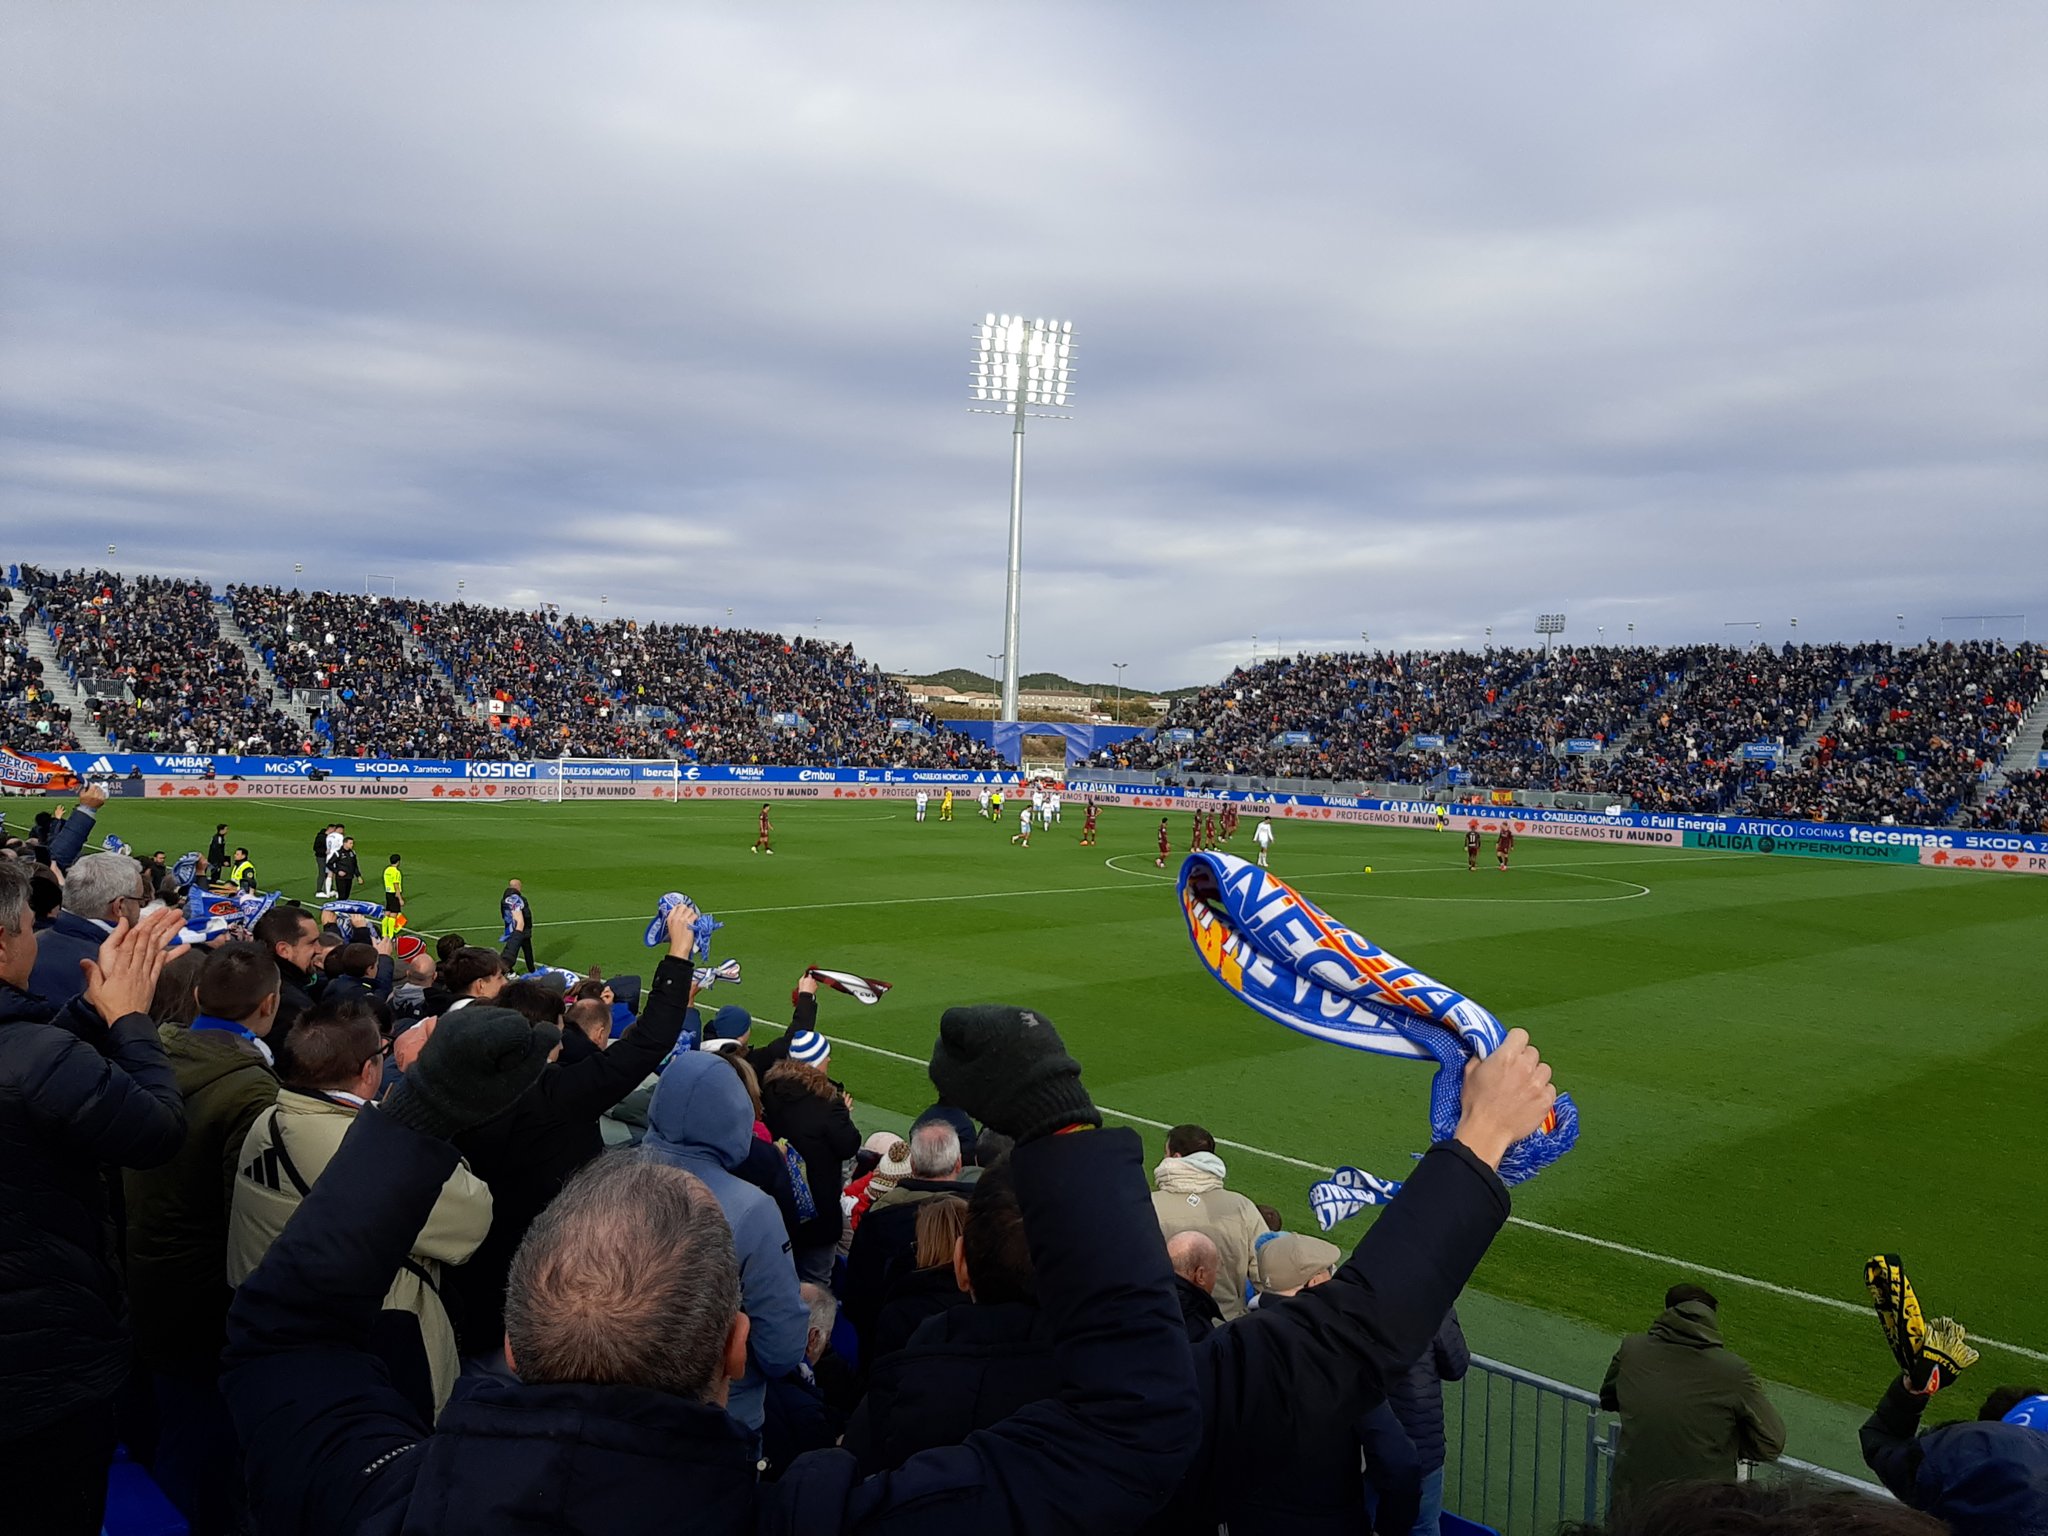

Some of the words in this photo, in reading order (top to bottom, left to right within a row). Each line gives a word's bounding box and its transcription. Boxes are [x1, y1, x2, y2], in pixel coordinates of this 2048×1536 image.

[165, 756, 212, 768] AMBAR
[265, 763, 295, 774] MGS
[413, 765, 452, 774] Zaratecno
[591, 767, 631, 776] MONCAYO
[799, 769, 836, 781] embou
[247, 784, 336, 795] PROTEGEMOS
[340, 785, 355, 795] TU
[360, 785, 408, 795] MUNDO
[581, 786, 594, 796] TU
[597, 786, 636, 796] MUNDO
[712, 787, 772, 797] PROTEGEMOS
[774, 787, 784, 797] TU
[786, 787, 819, 797] MUNDO
[933, 789, 942, 797] TU
[1068, 781, 1117, 794] CARAVAN
[1084, 794, 1093, 802] TU
[1094, 794, 1120, 803] MUNDO
[1328, 796, 1358, 807] AMBAR
[1240, 803, 1270, 814] MUNDO
[1336, 810, 1395, 823] PROTEGEMOS
[1398, 814, 1409, 824] TU
[1551, 813, 1587, 824] AZULEJOS
[1587, 815, 1633, 827] MONCAYO
[1651, 815, 1674, 828] Full
[1677, 817, 1726, 833] Energía
[1737, 821, 1794, 837] ARTICO
[1799, 826, 1845, 838] COCINAS
[1531, 823, 1607, 838] PROTEGEMOS
[1609, 829, 1623, 840] TU
[1626, 830, 1673, 843] MUNDO
[1849, 826, 1953, 848] tecemac
[1698, 833, 1753, 850] LALIGA
[1777, 840, 1889, 857] HYPERMOTION
[2029, 857, 2047, 869] PR
